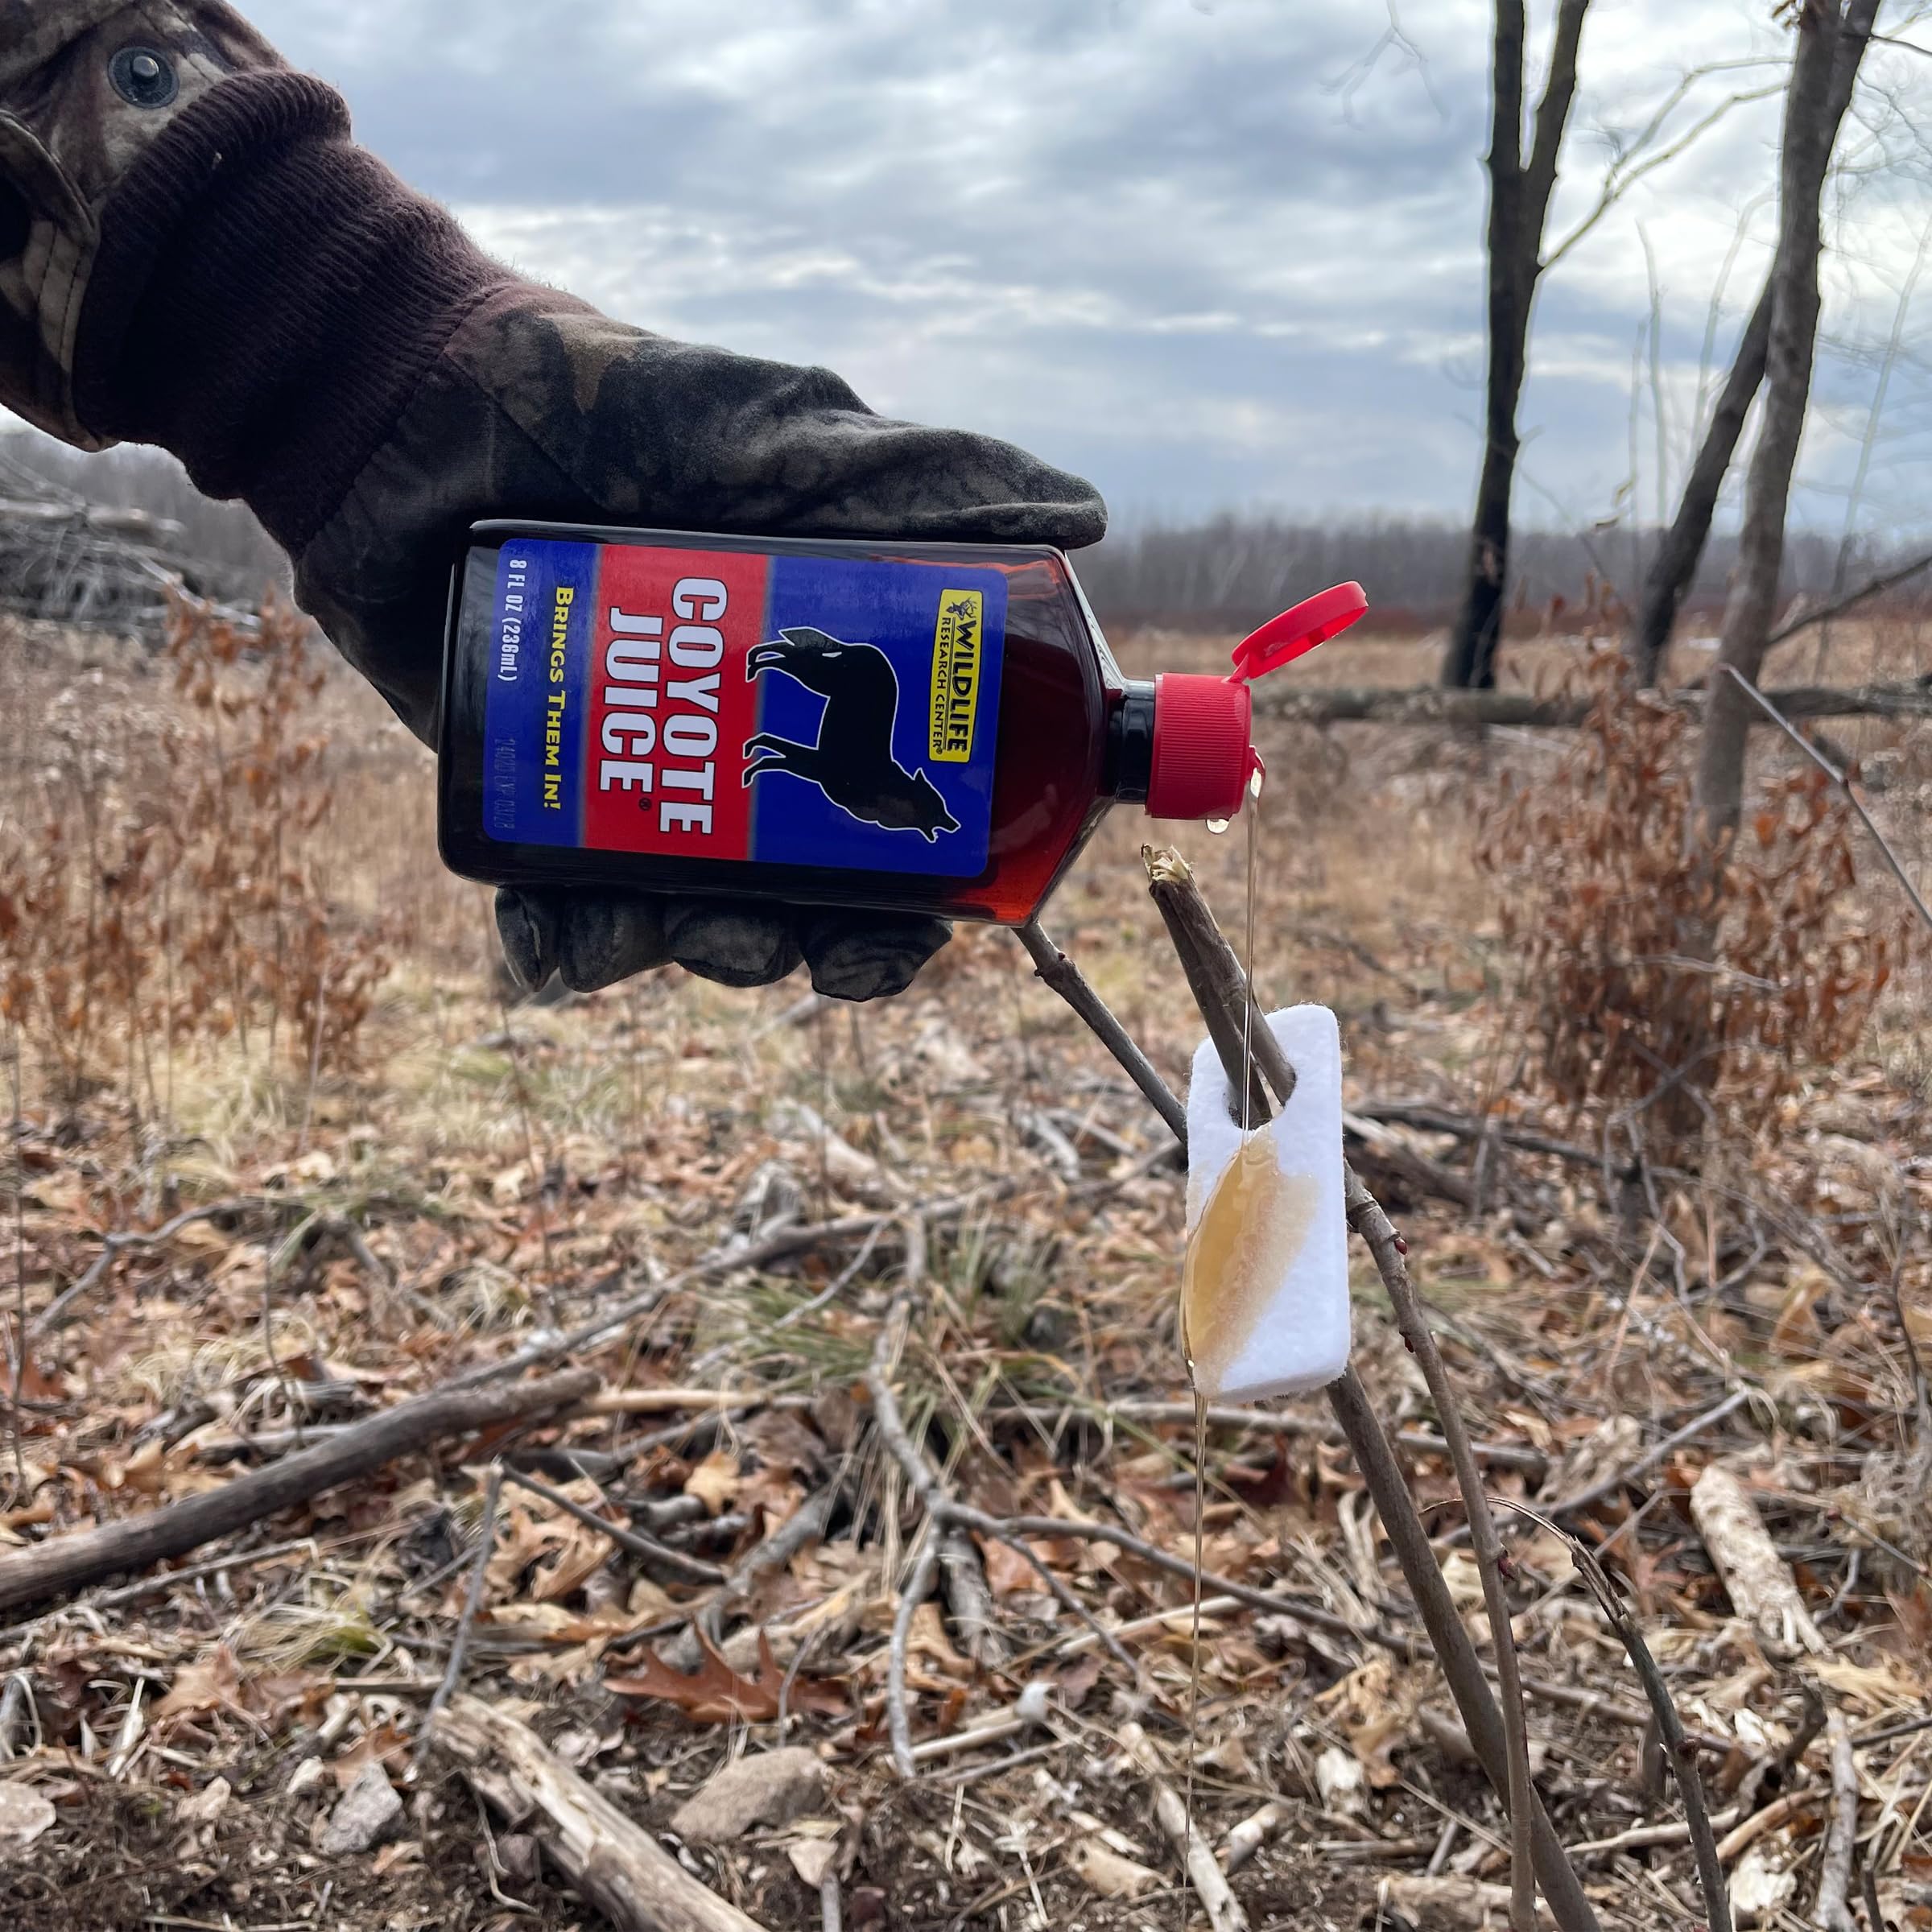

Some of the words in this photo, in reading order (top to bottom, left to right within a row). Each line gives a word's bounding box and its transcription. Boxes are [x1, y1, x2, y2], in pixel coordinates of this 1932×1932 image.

[508, 574, 526, 588] FL
[510, 559, 527, 568] 8
[506, 594, 523, 612] OZ
[549, 586, 574, 683] BRINGS
[497, 617, 522, 682] (236mL)
[936, 617, 951, 689] RESEARCH
[659, 577, 729, 834] COYOTE
[947, 620, 976, 752] WILDLIFE
[544, 690, 566, 766] THEM
[543, 774, 562, 810] IN!
